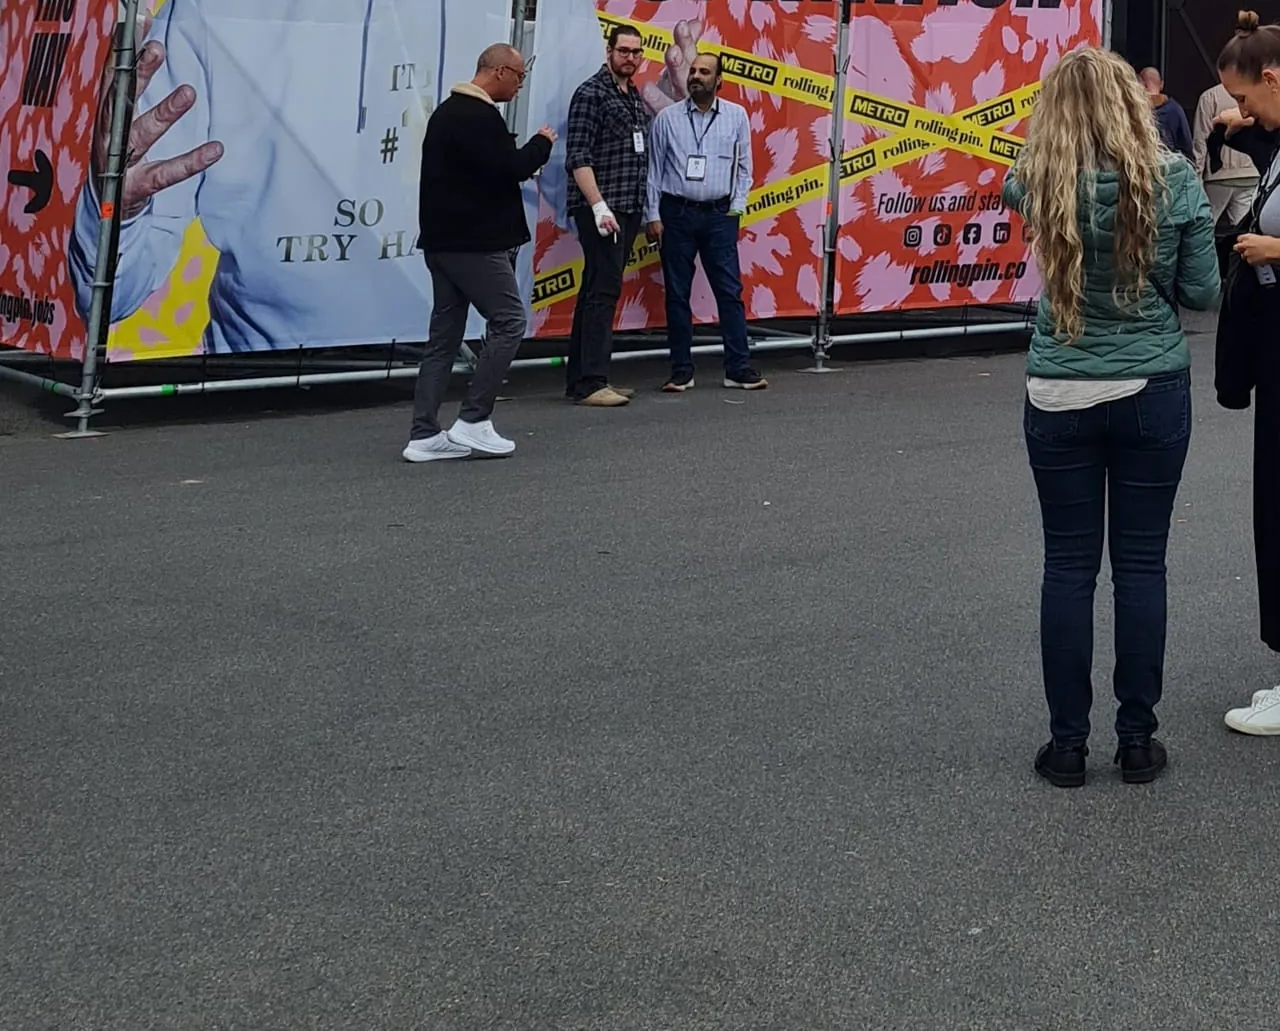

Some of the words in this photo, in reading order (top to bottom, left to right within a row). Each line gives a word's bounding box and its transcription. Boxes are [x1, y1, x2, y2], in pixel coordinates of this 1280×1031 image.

[23, 32, 71, 107] WAY
[721, 54, 777, 83] METRO
[783, 75, 829, 102] rolling
[853, 97, 908, 125] METRO
[914, 118, 957, 144] rolling
[334, 198, 384, 228] SO
[746, 186, 794, 214] rolling
[877, 192, 926, 215] Follow
[928, 195, 946, 212] us
[947, 191, 977, 213] and
[276, 234, 357, 263] TRY
